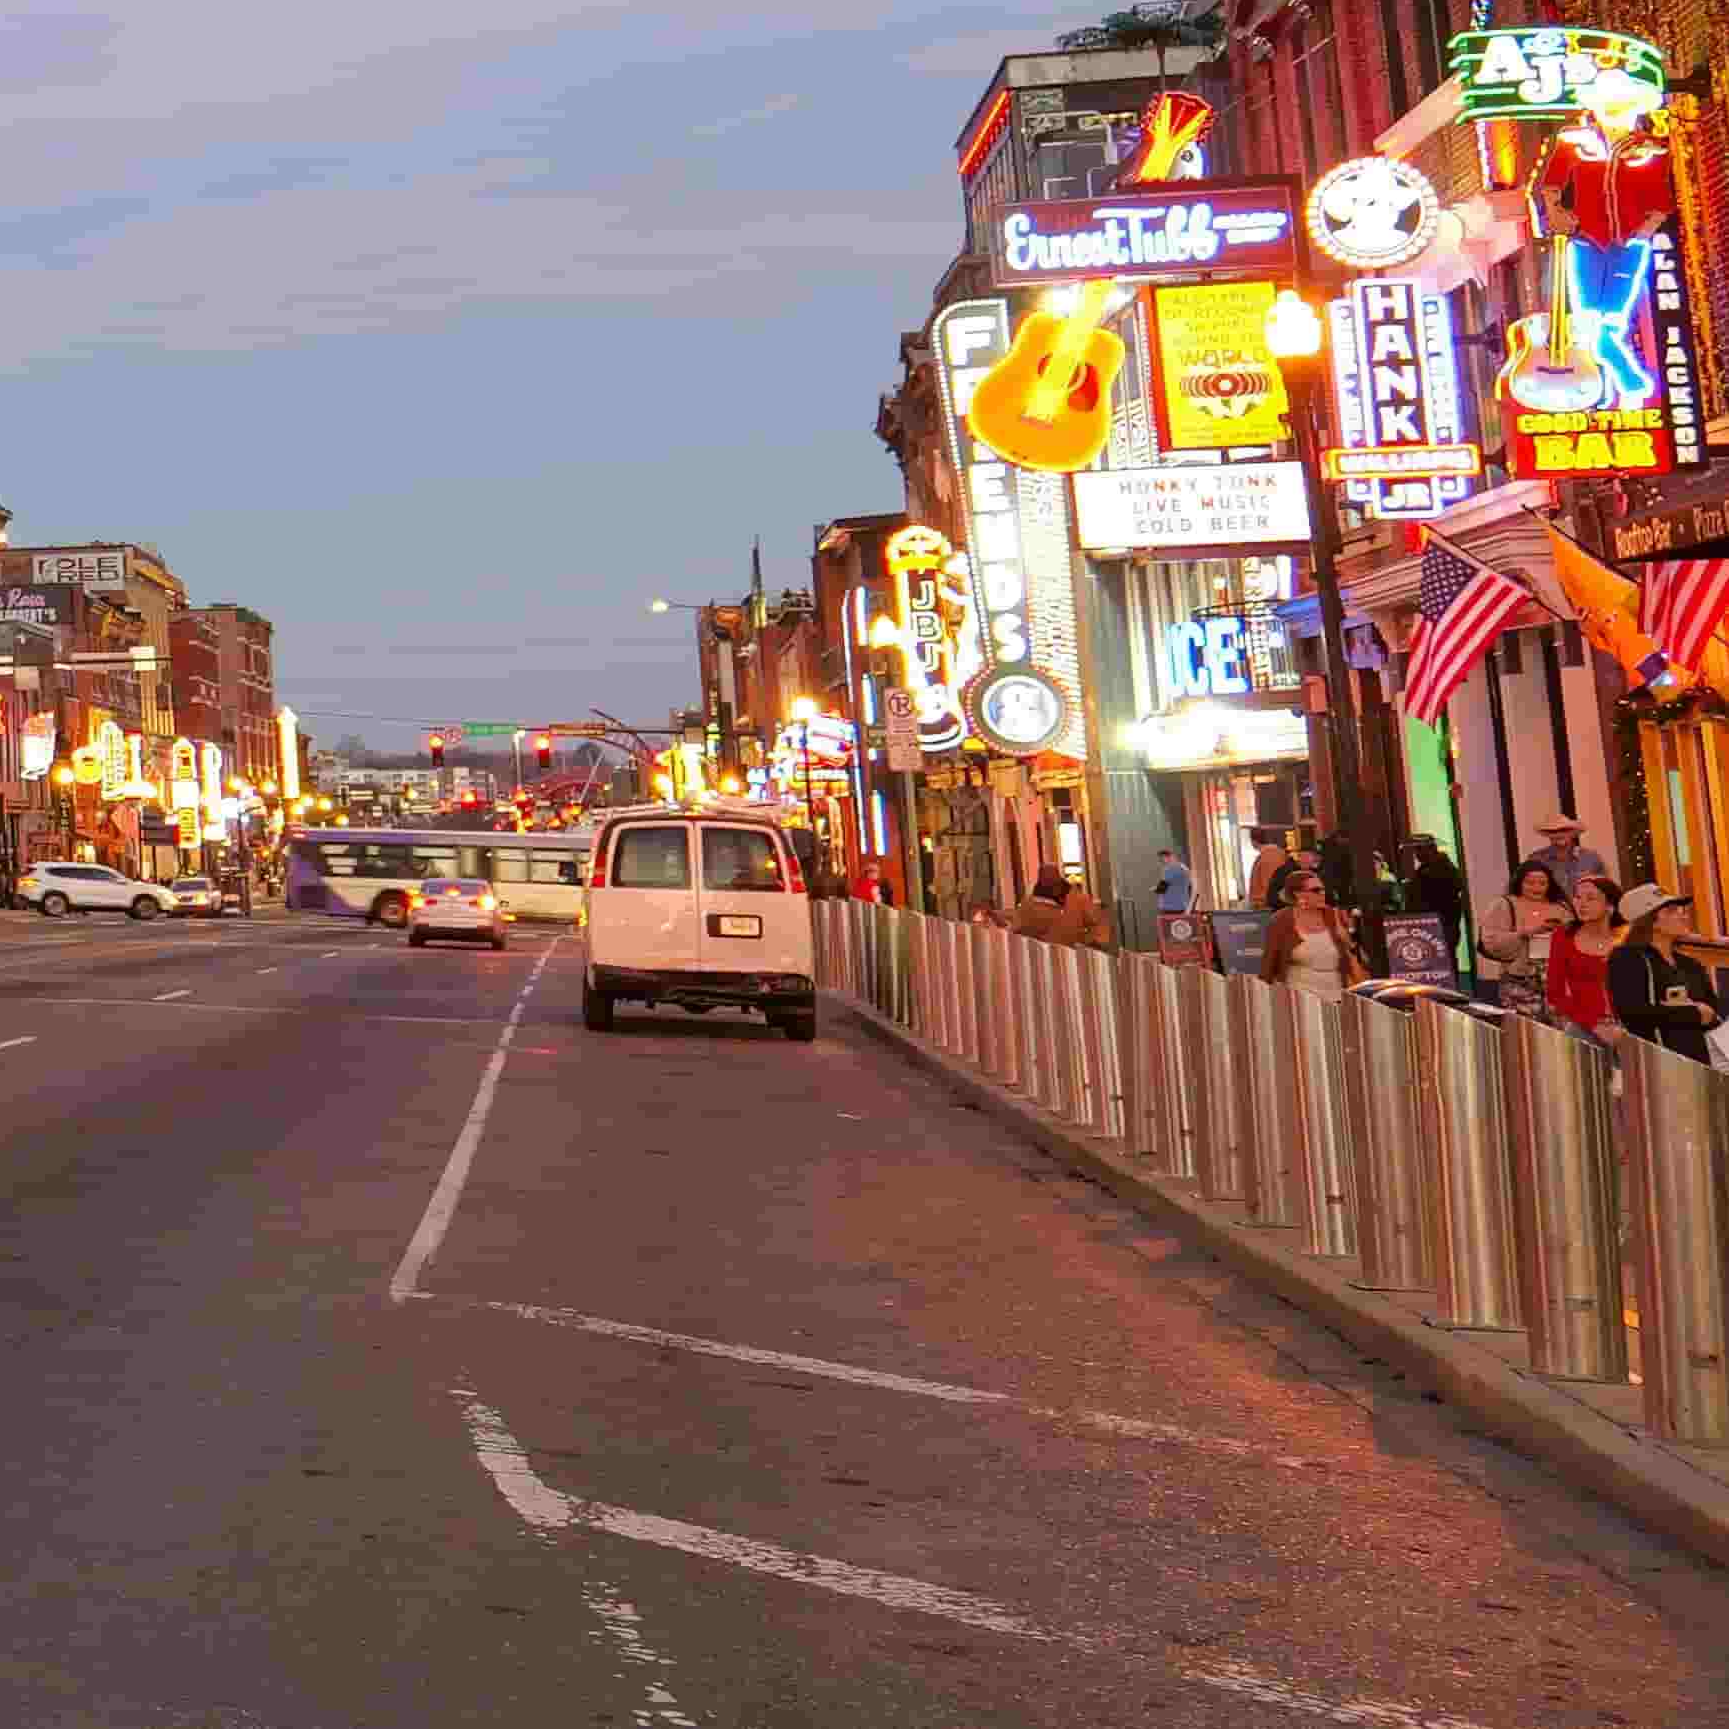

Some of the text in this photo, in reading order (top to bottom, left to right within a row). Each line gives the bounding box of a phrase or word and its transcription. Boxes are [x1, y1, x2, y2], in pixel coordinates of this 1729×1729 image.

[1004, 213, 1131, 271] Ernest
[1093, 202, 1219, 266] Tubb
[1651, 232, 1682, 311] ALAN
[1365, 283, 1423, 443] HANK
[1664, 326, 1700, 463] JACKSON
[1533, 431, 1658, 471] BAR
[1132, 492, 1270, 515] LIVE MUSIC
